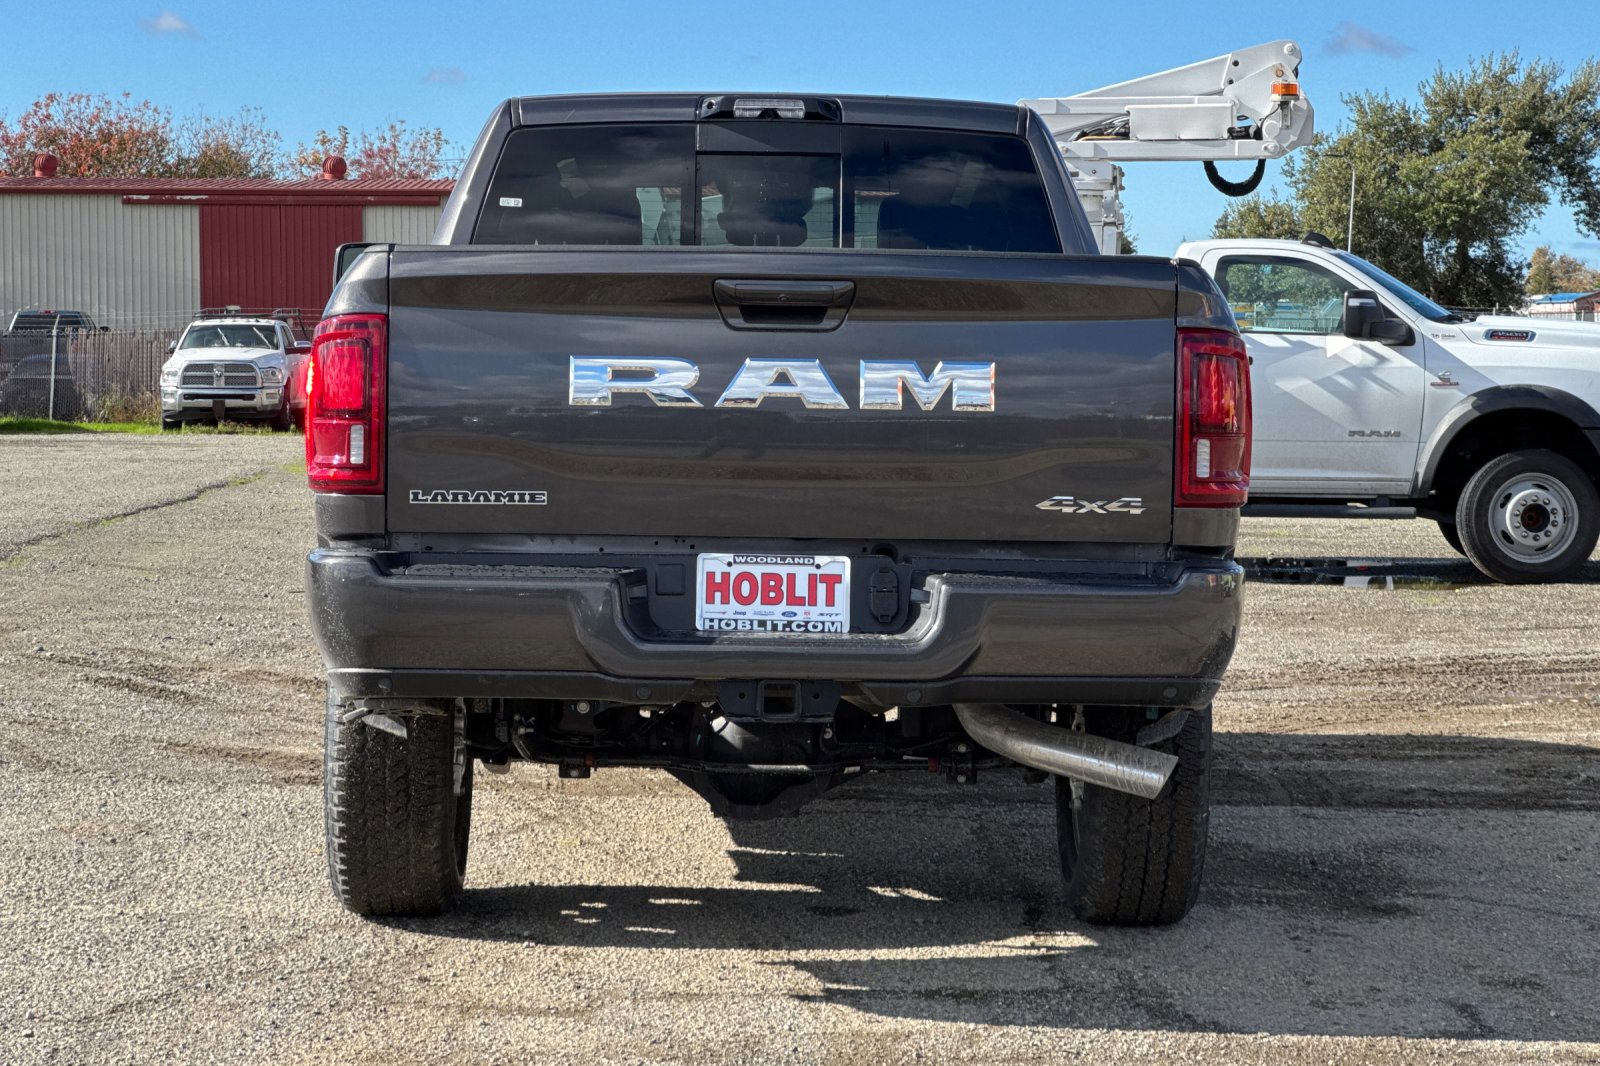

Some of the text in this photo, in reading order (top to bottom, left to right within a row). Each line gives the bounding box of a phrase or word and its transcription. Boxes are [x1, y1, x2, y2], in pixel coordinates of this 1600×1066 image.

[569, 355, 996, 412] RAM
[409, 490, 547, 505] LARAMIE
[735, 556, 814, 565] WOODLAND
[705, 571, 842, 607] HOBLIT
[704, 618, 842, 632] HOBLIT.COM
